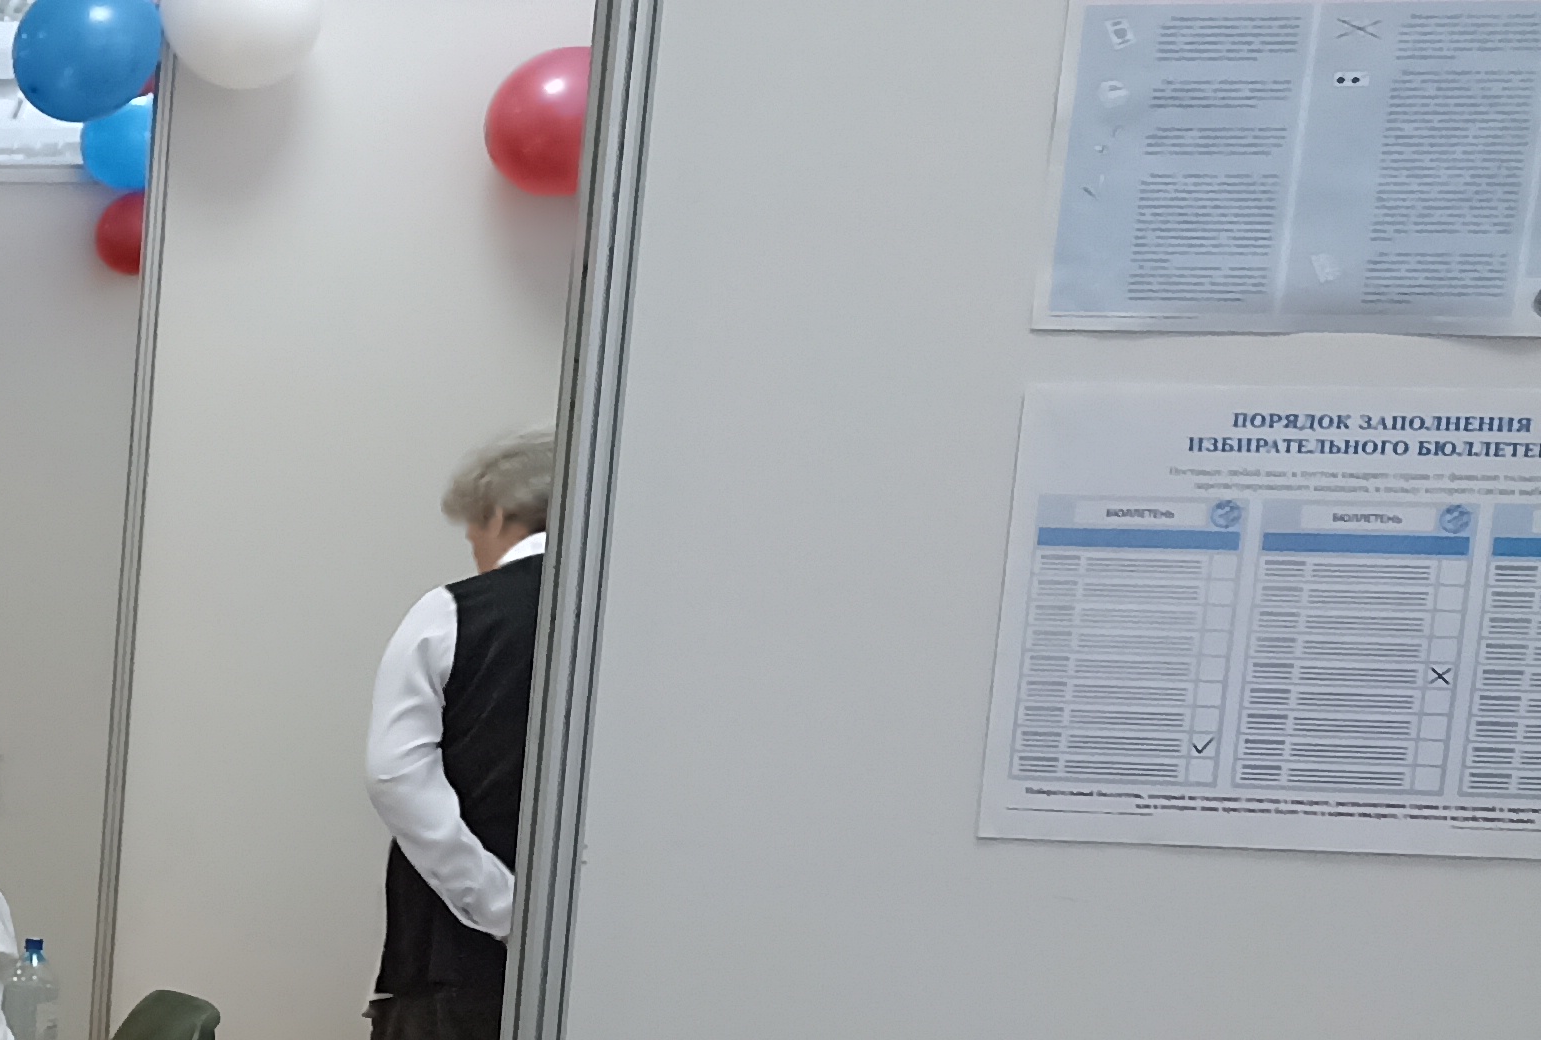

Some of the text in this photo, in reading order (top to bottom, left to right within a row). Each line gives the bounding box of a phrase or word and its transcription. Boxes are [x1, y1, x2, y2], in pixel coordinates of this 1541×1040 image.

[1232, 411, 1532, 434] ПОРЯДОК ЗАПОЛНЕНИЯ
[1187, 436, 1541, 460] ИЗБИРАТЕЛЬНОГО БЮЛЛЕТЕ
